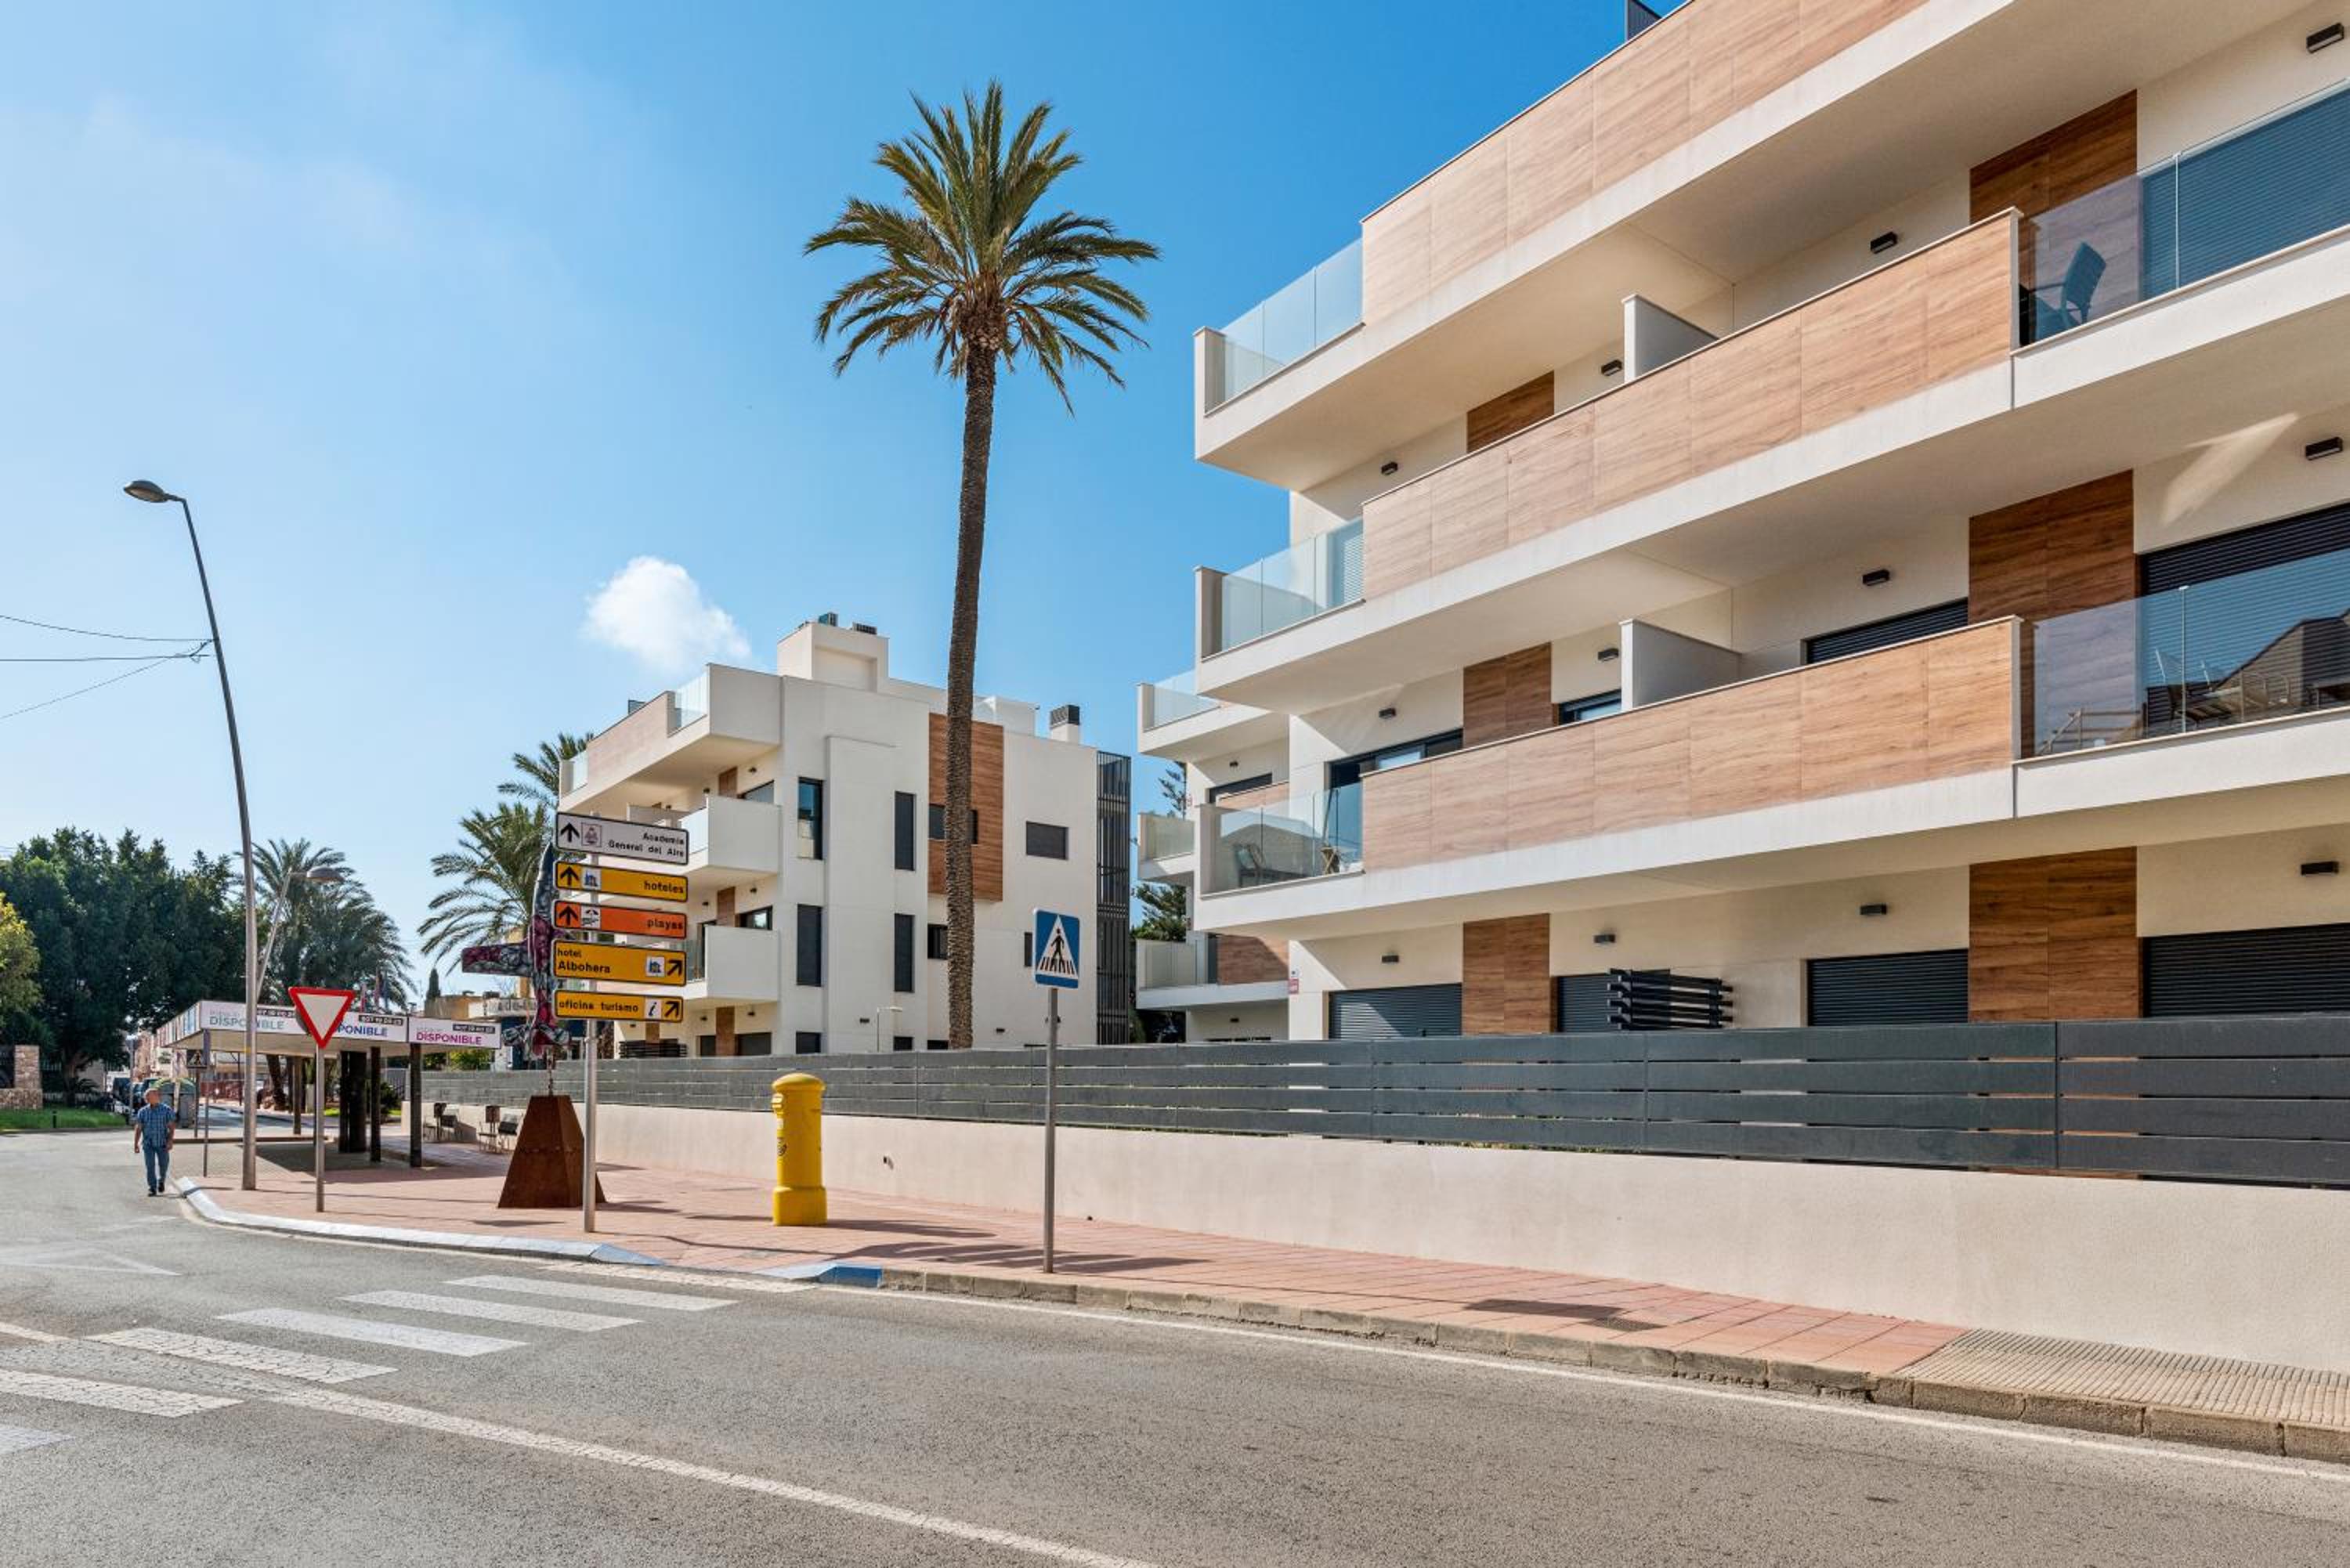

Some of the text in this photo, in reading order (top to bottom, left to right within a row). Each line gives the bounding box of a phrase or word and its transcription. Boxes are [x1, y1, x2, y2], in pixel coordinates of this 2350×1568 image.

[642, 833, 684, 845] Academia
[608, 840, 684, 857] General del Aire
[643, 880, 684, 894] hoteles
[646, 918, 683, 930] playas
[557, 947, 582, 958] hotel
[558, 961, 610, 974] Albohera
[559, 999, 594, 1010] oficina
[601, 1002, 638, 1013] turismo
[209, 1015, 284, 1030] DISPOIBLE
[337, 1023, 388, 1037] PONIBLE
[416, 1031, 482, 1046] DISPONIBLE
